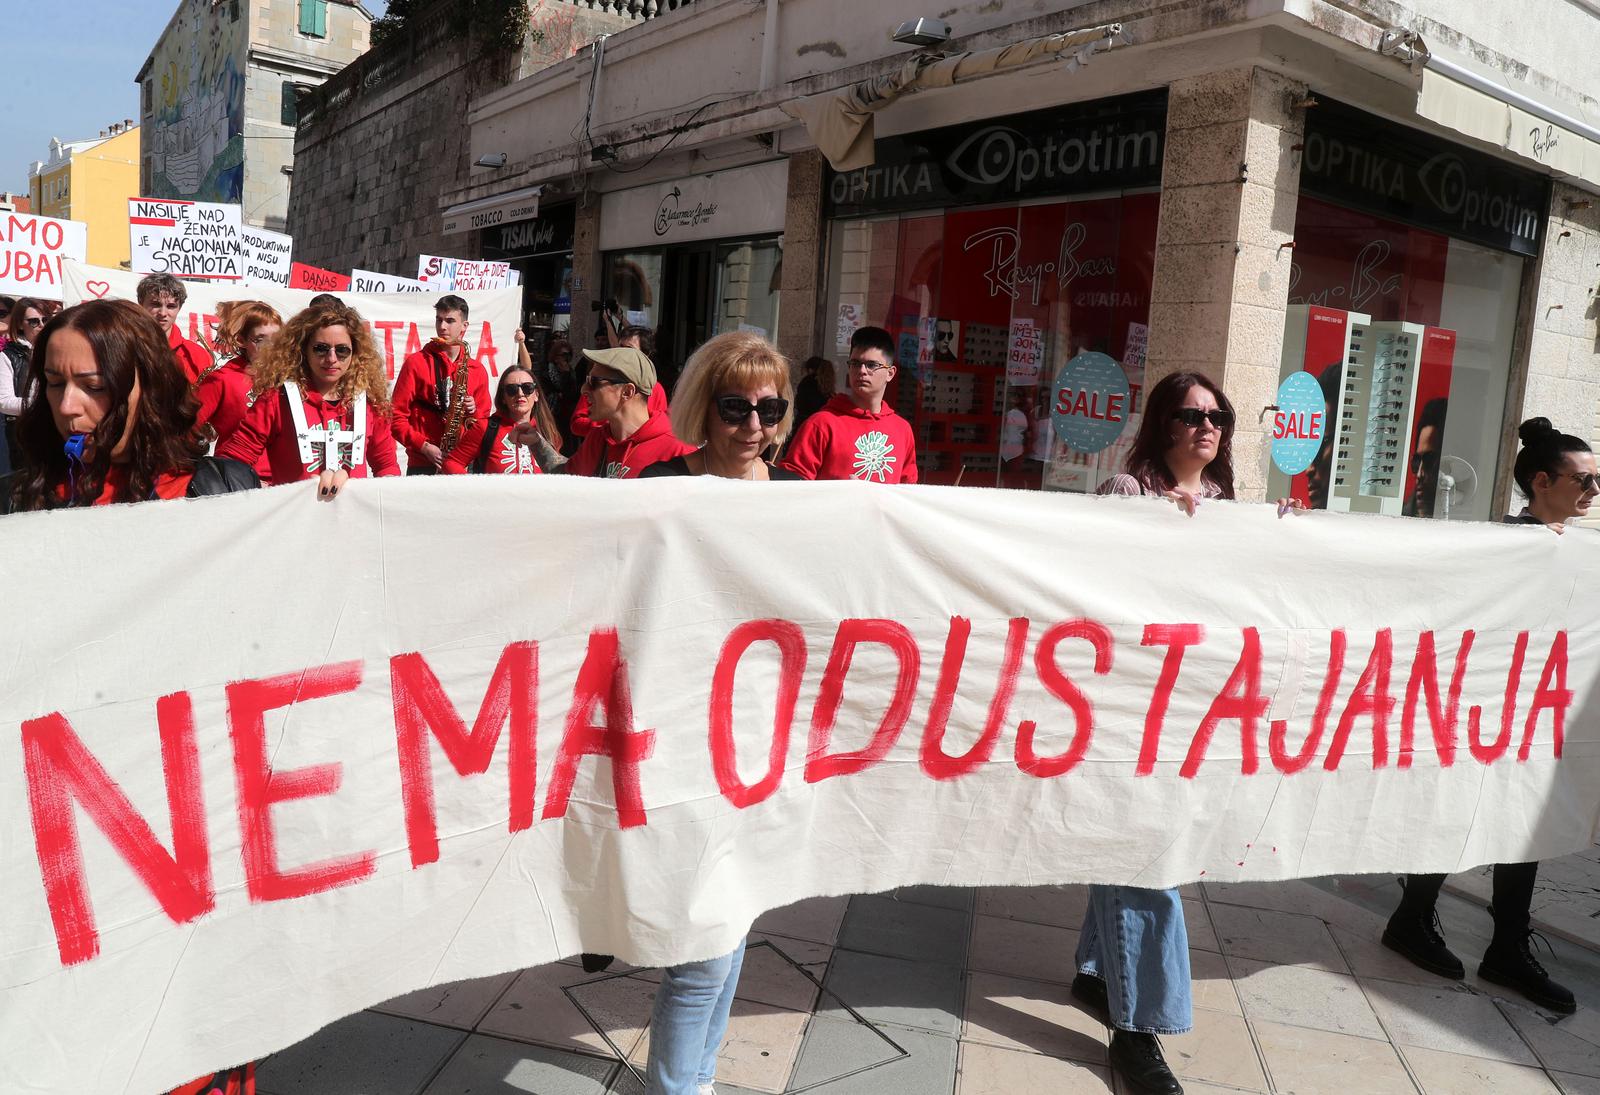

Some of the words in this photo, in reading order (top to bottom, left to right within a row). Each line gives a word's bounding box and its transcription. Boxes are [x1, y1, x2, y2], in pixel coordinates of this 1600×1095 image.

[830, 163, 934, 204] OPTIKA
[977, 124, 1159, 193] Optotim
[1304, 132, 1406, 201] OPTIKA
[1441, 159, 1539, 241] Optotim
[137, 202, 190, 222] NASILJE
[198, 209, 225, 223] NAD
[471, 210, 503, 228] TOBACCO
[184, 219, 236, 238] ŽENAMA
[501, 221, 537, 250] TISAK
[534, 220, 554, 252] plus
[138, 235, 150, 247] JE
[161, 237, 242, 256] NACIONALNA
[150, 251, 237, 275] SRAMOTA
[256, 252, 279, 265] NISU
[247, 265, 289, 289] PRODAJU!
[302, 270, 337, 287] DANAS
[1055, 386, 1125, 423] SALE
[1272, 409, 1322, 440] SALE
[20, 626, 657, 967] NEMA
[707, 614, 1575, 809] ODUSTAJANJA
